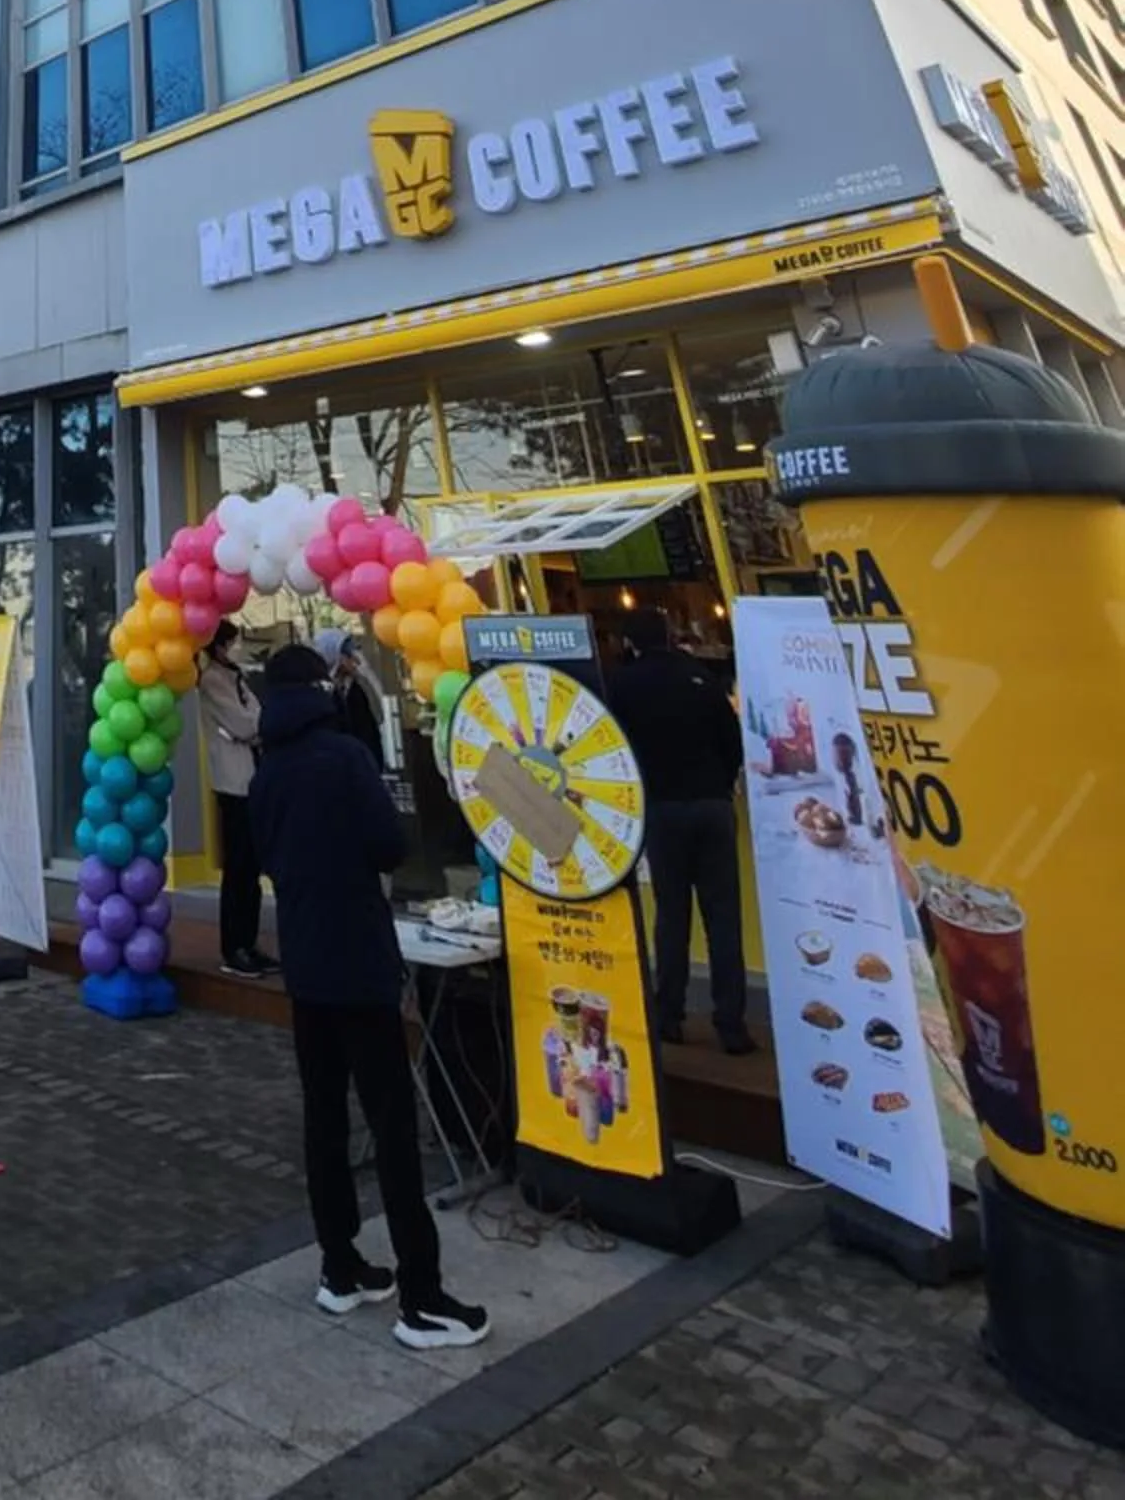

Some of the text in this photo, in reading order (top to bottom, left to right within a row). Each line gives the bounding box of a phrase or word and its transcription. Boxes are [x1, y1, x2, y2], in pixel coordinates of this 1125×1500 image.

[198, 171, 388, 288] MEGA
[467, 56, 761, 213] COFFEE
[773, 235, 885, 274] MEGA COFFEE
[777, 446, 850, 480] COFFEE
[533, 630, 577, 649] COFFEE
